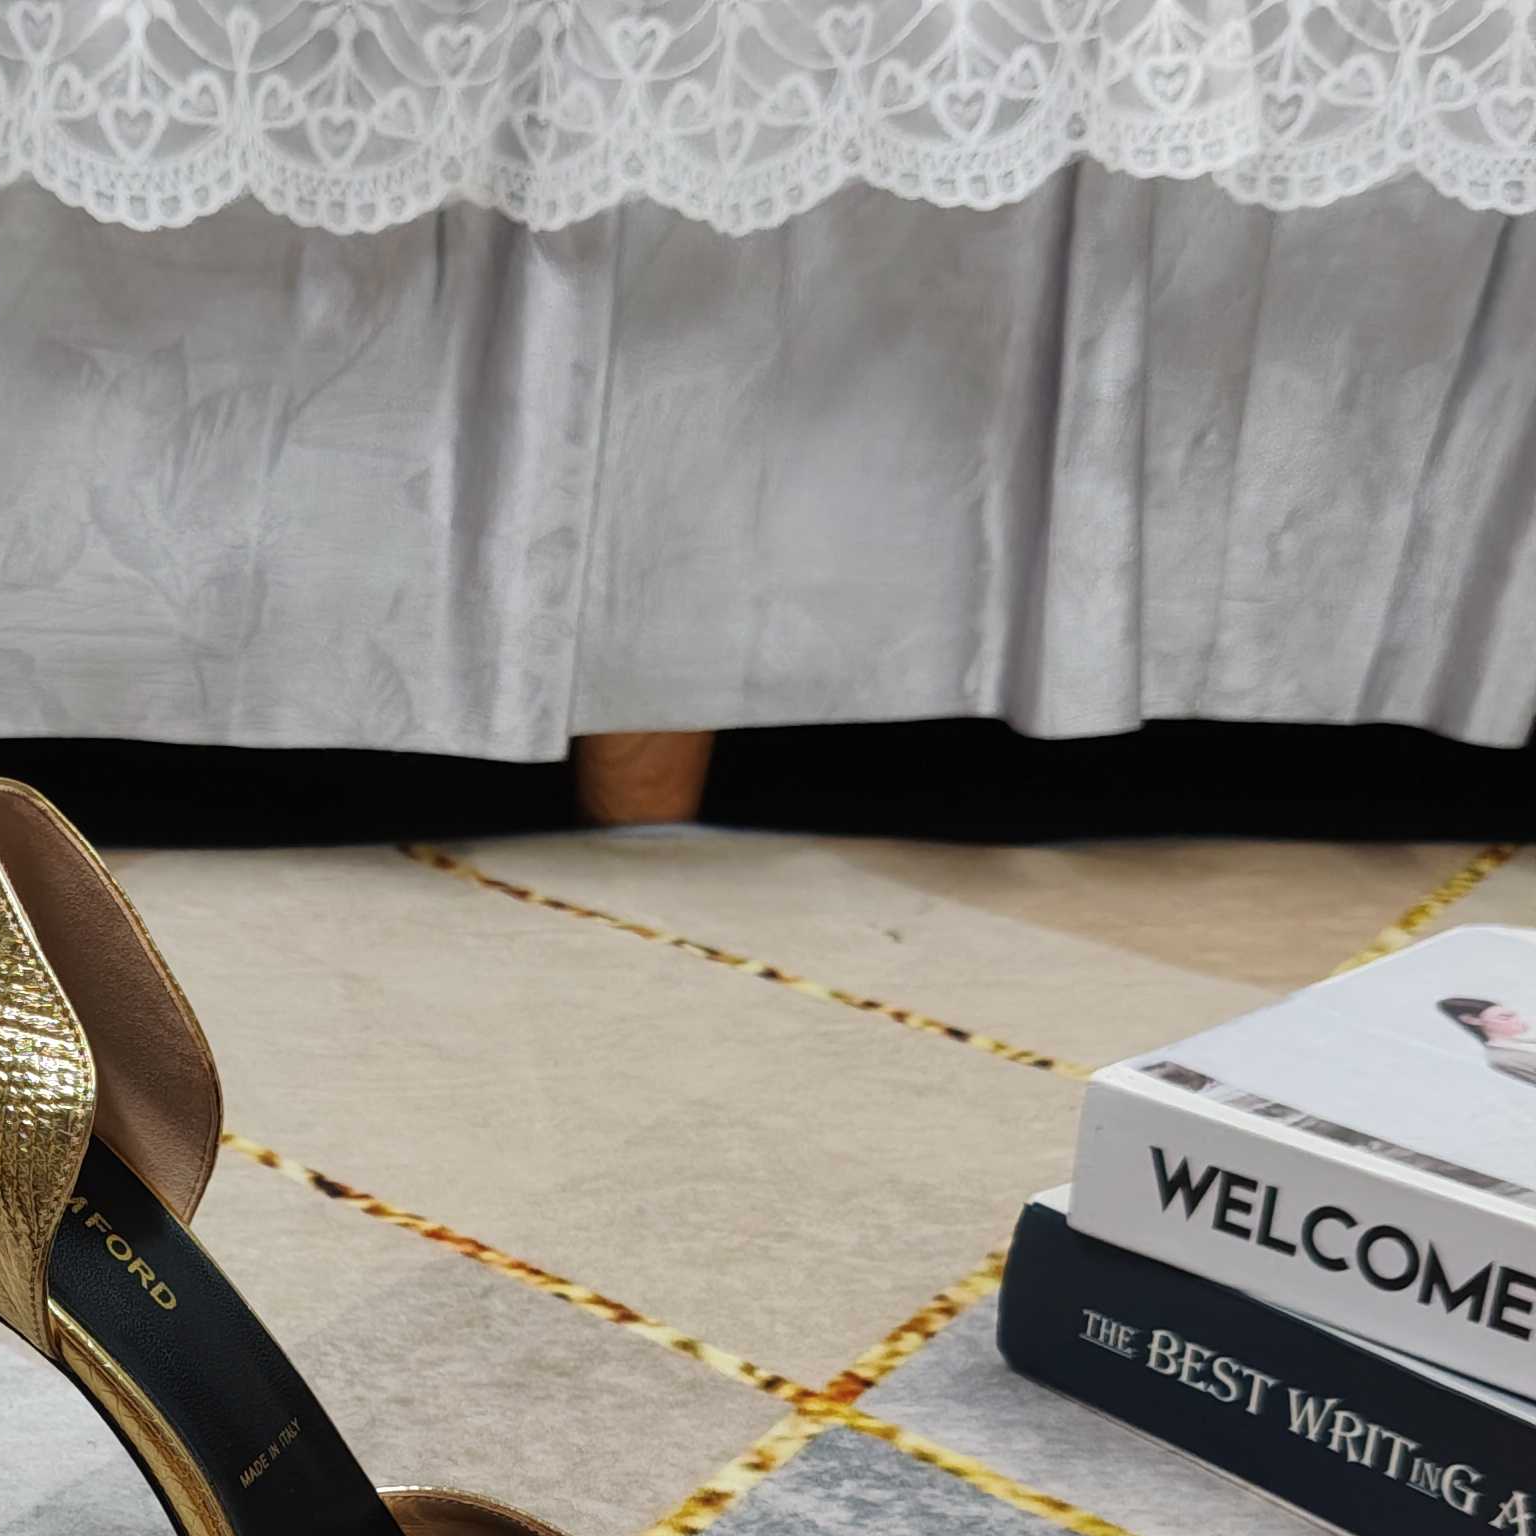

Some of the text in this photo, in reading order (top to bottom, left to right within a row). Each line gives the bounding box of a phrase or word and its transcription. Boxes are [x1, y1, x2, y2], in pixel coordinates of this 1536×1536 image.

[84, 1212, 177, 1310] FORD
[1150, 1144, 1536, 1342] WELCOME
[1079, 1308, 1138, 1358] THE
[1144, 1329, 1277, 1416] BEST
[240, 1417, 301, 1488] MADE IN ITALY
